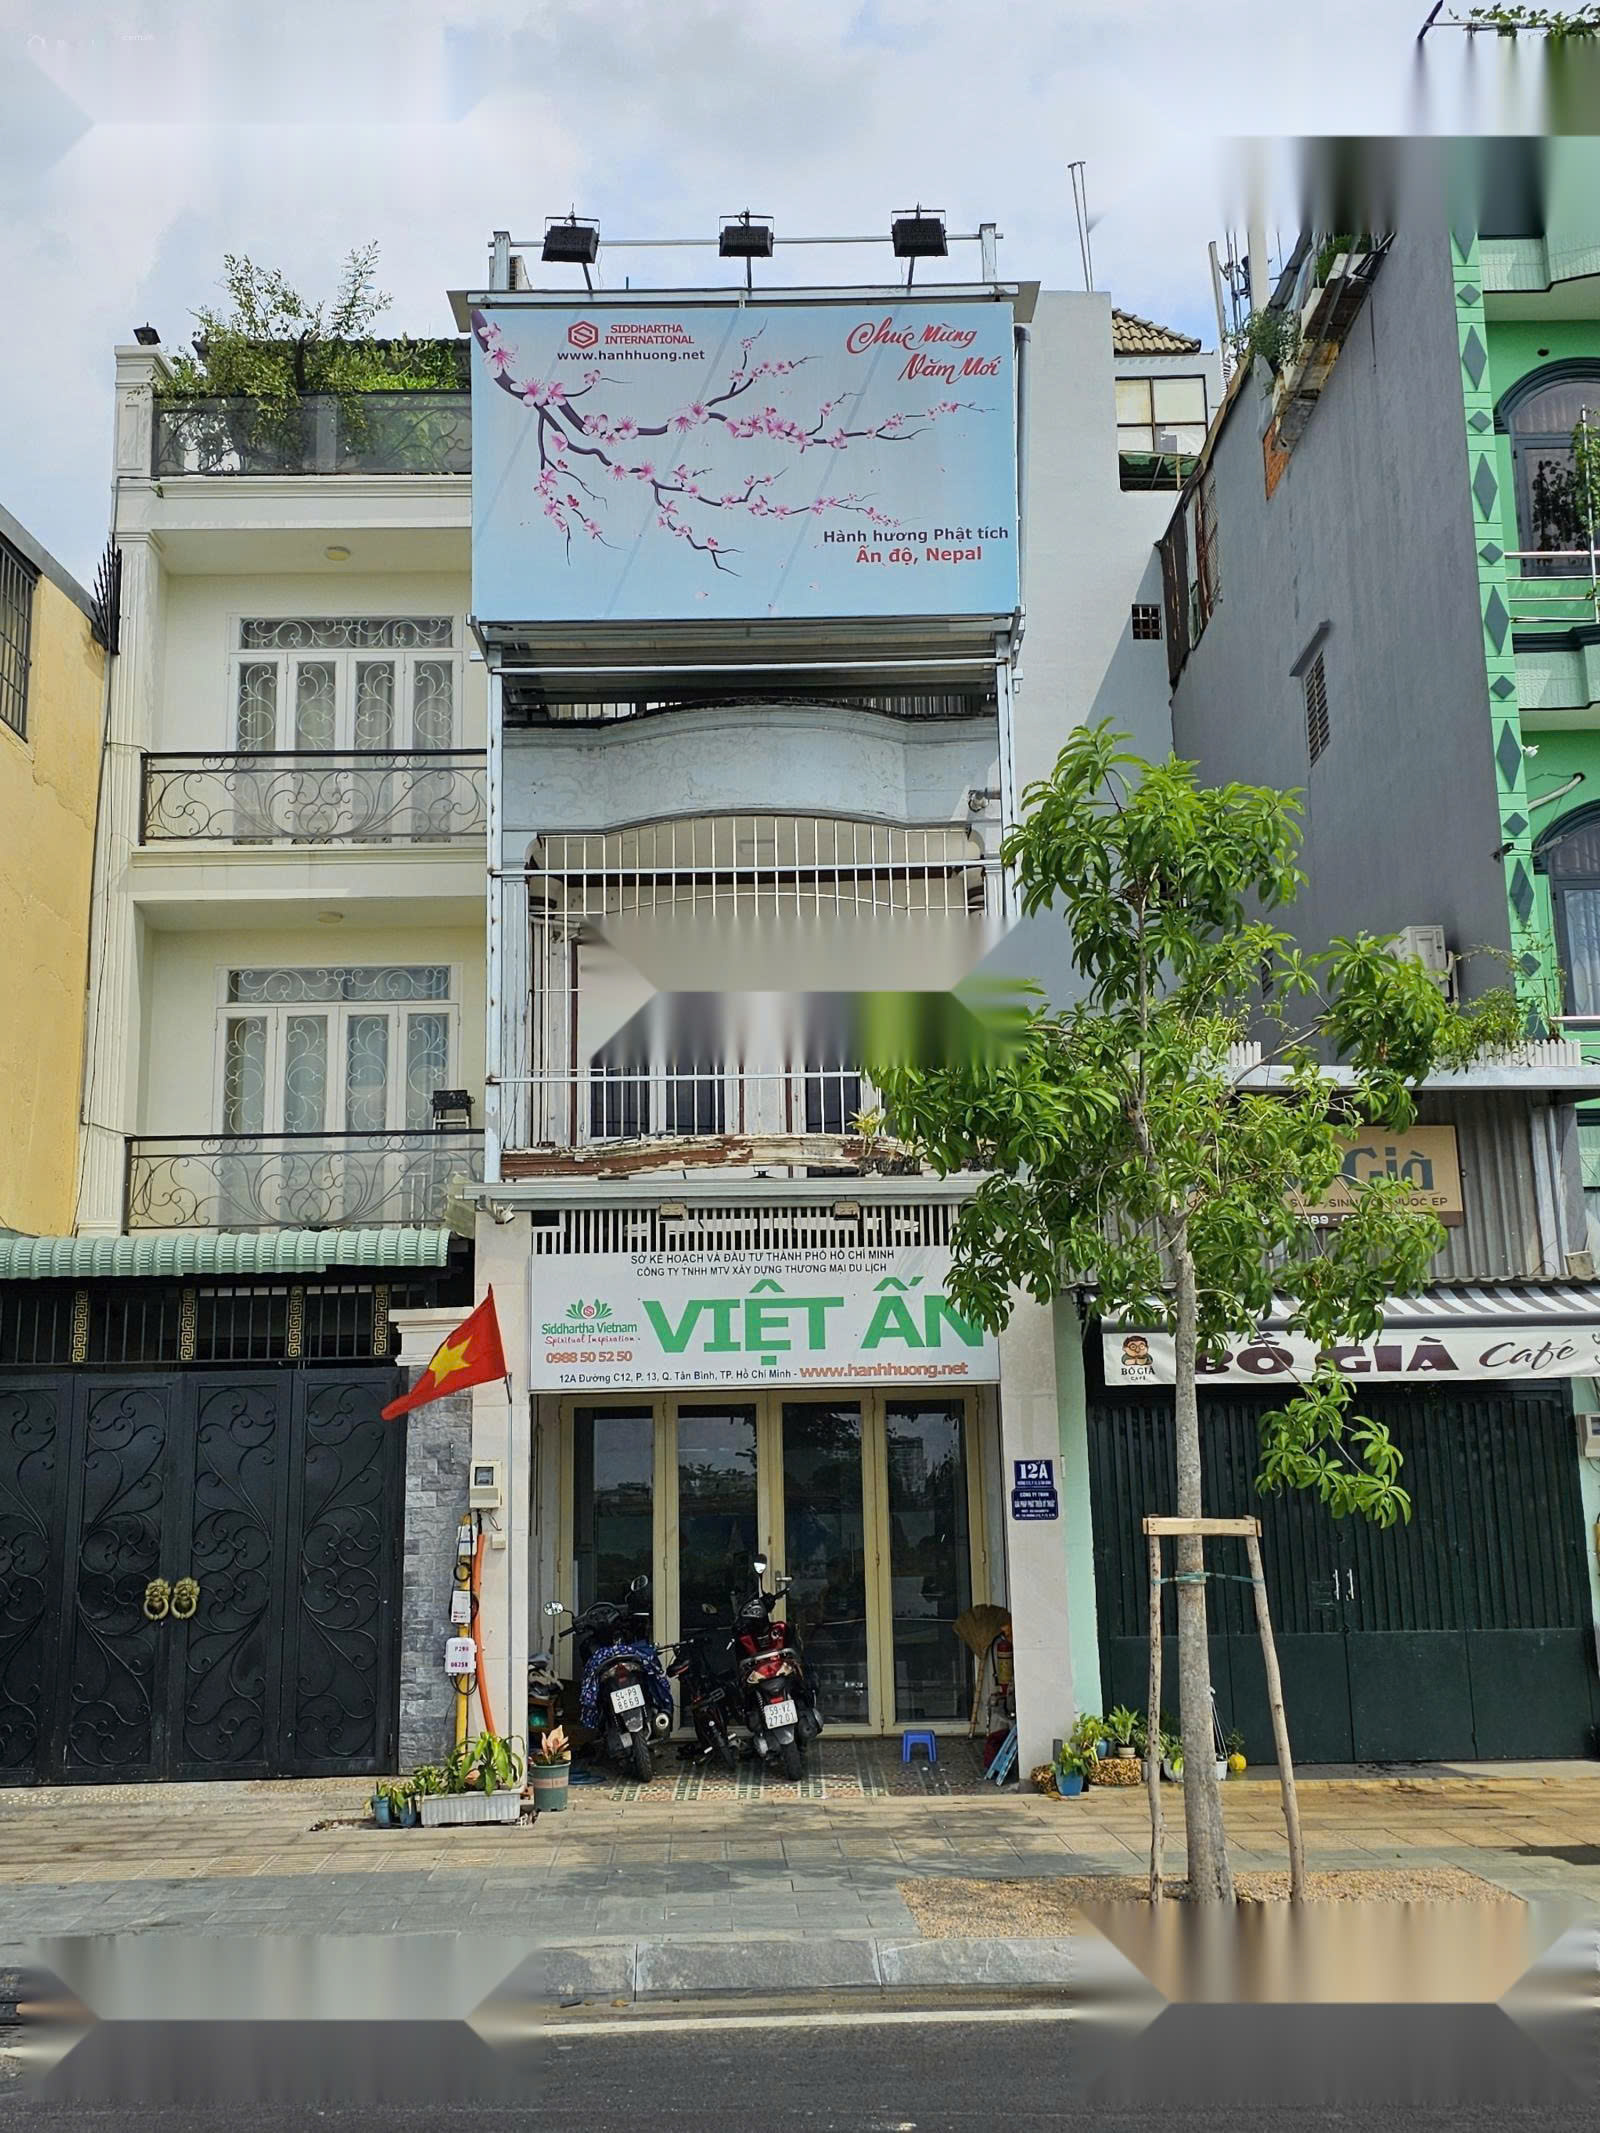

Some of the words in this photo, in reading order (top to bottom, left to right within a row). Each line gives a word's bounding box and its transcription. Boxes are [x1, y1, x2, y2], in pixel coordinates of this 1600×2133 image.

[610, 324, 683, 334] SIDDHARTHA
[846, 316, 920, 354] Chúc
[918, 323, 977, 349] Mừng
[604, 335, 694, 345] INTERNATIONAL
[556, 350, 705, 362] www.hanhhuong.net
[898, 353, 957, 384] Năm
[958, 356, 1003, 376] Mới
[823, 530, 867, 543] Hành
[873, 530, 928, 543] hương
[934, 527, 972, 543] Phật
[977, 526, 1009, 540] tích
[856, 545, 881, 563] Ấn
[888, 546, 918, 565] độ,
[926, 546, 982, 564] Nepal
[1342, 1146, 1434, 1191] Già
[868, 1249, 895, 1260] MINH
[636, 1266, 665, 1277] CÔNG
[667, 1267, 679, 1277] TY
[681, 1267, 707, 1276] TNHH
[710, 1266, 730, 1276] MTV
[731, 1265, 751, 1276] XÂY
[753, 1265, 782, 1276] DỰNG
[784, 1264, 827, 1275] THƯƠNG
[829, 1263, 847, 1275] MẠI
[849, 1263, 862, 1272] DU
[865, 1263, 887, 1274] LỊCH
[541, 1322, 595, 1335] Siddhartha
[597, 1321, 637, 1333] Vietnam
[642, 1278, 845, 1366] VIỆT
[860, 1276, 985, 1349] ẤN
[545, 1352, 577, 1363] 0988
[580, 1351, 596, 1363] 50
[598, 1351, 614, 1362] 52
[616, 1350, 633, 1362] 50
[1315, 1336, 1459, 1374] GIÀ
[1478, 1339, 1579, 1370] Café
[559, 1373, 576, 1384] 12A
[578, 1373, 611, 1384] Đường
[613, 1372, 633, 1383] C12,
[636, 1372, 644, 1382] P.
[647, 1371, 659, 1382] 13,
[662, 1371, 673, 1381] Q.
[675, 1370, 691, 1381] Tân
[719, 1370, 734, 1380] TP.
[751, 1368, 766, 1379] Chí
[769, 1368, 791, 1378] Minh
[800, 1363, 969, 1380] www.hanhhuong.net
[1020, 1463, 1048, 1479] 12A
